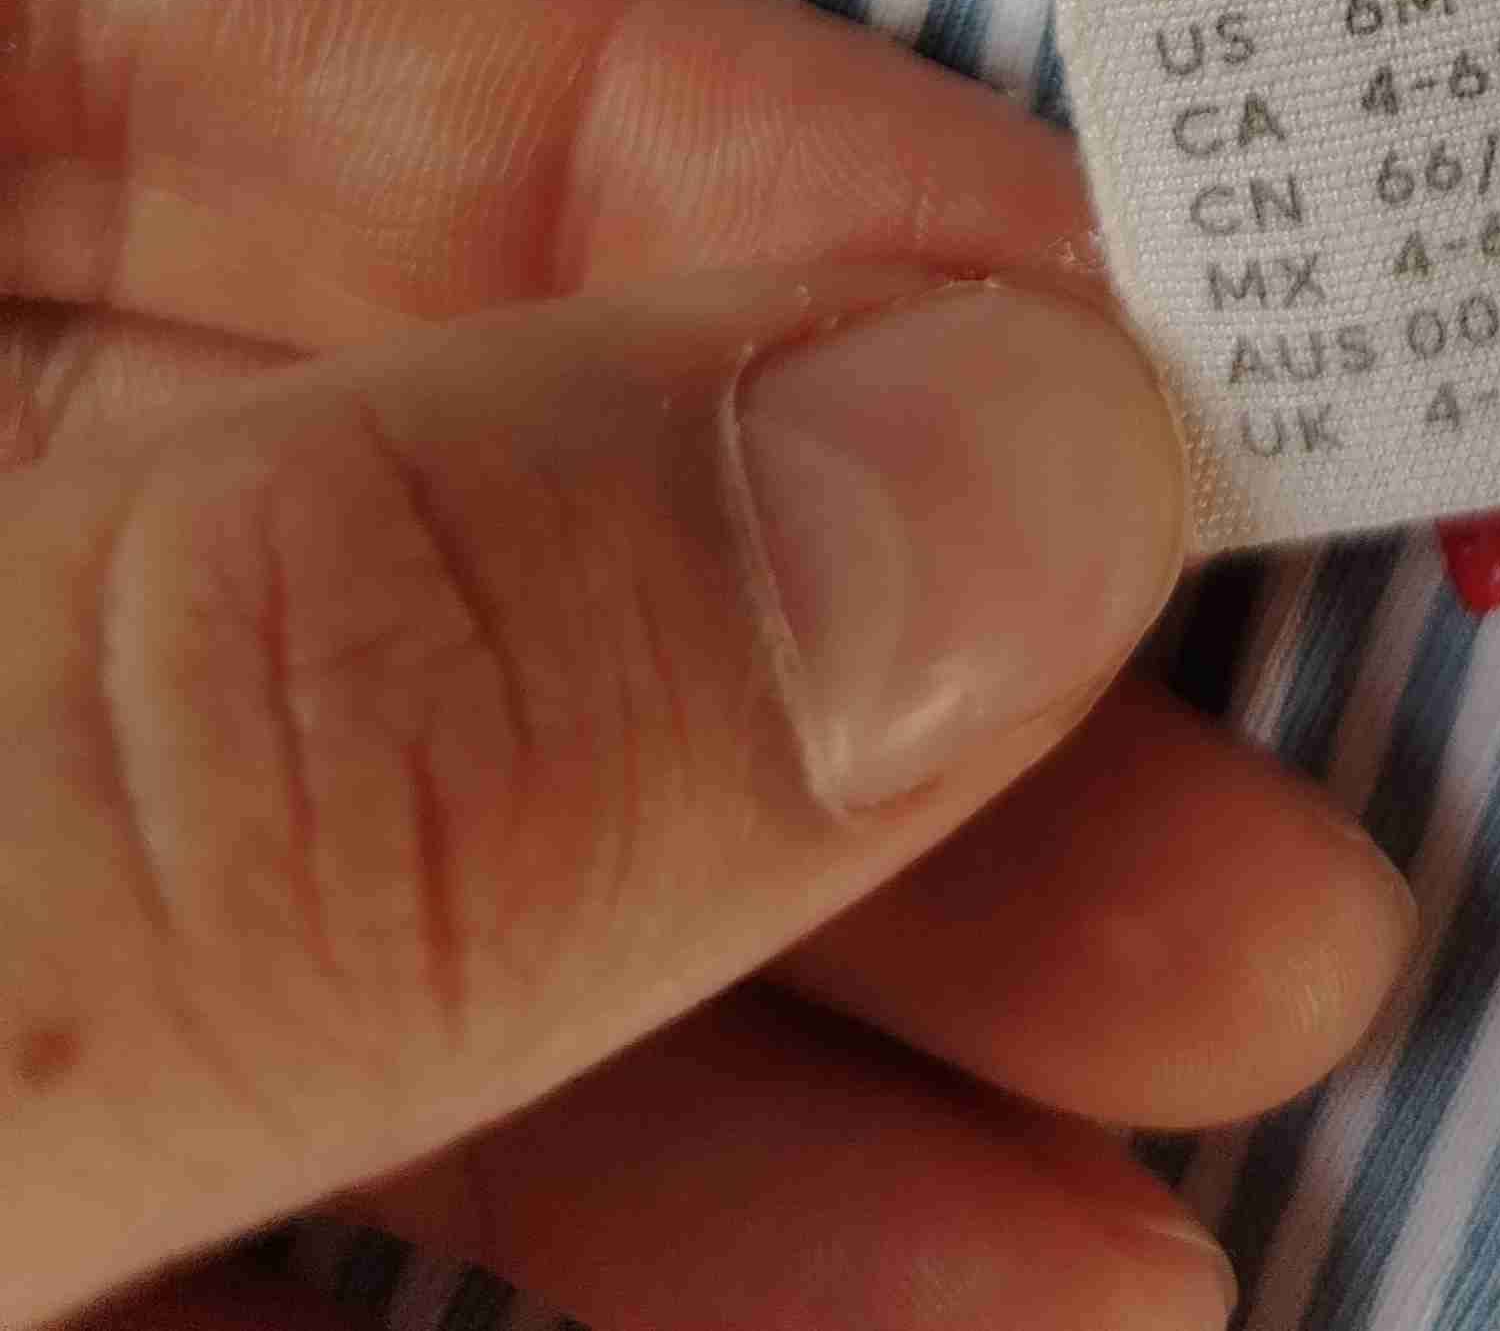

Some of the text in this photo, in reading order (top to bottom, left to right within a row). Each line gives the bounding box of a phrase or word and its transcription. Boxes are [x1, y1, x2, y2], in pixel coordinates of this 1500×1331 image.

[1157, 12, 1254, 75] US
[1173, 93, 1285, 158] CA
[1190, 172, 1303, 236] CN
[1208, 253, 1326, 310] MX
[1228, 294, 1499, 384] AUS 00
[1241, 403, 1344, 458] UK
